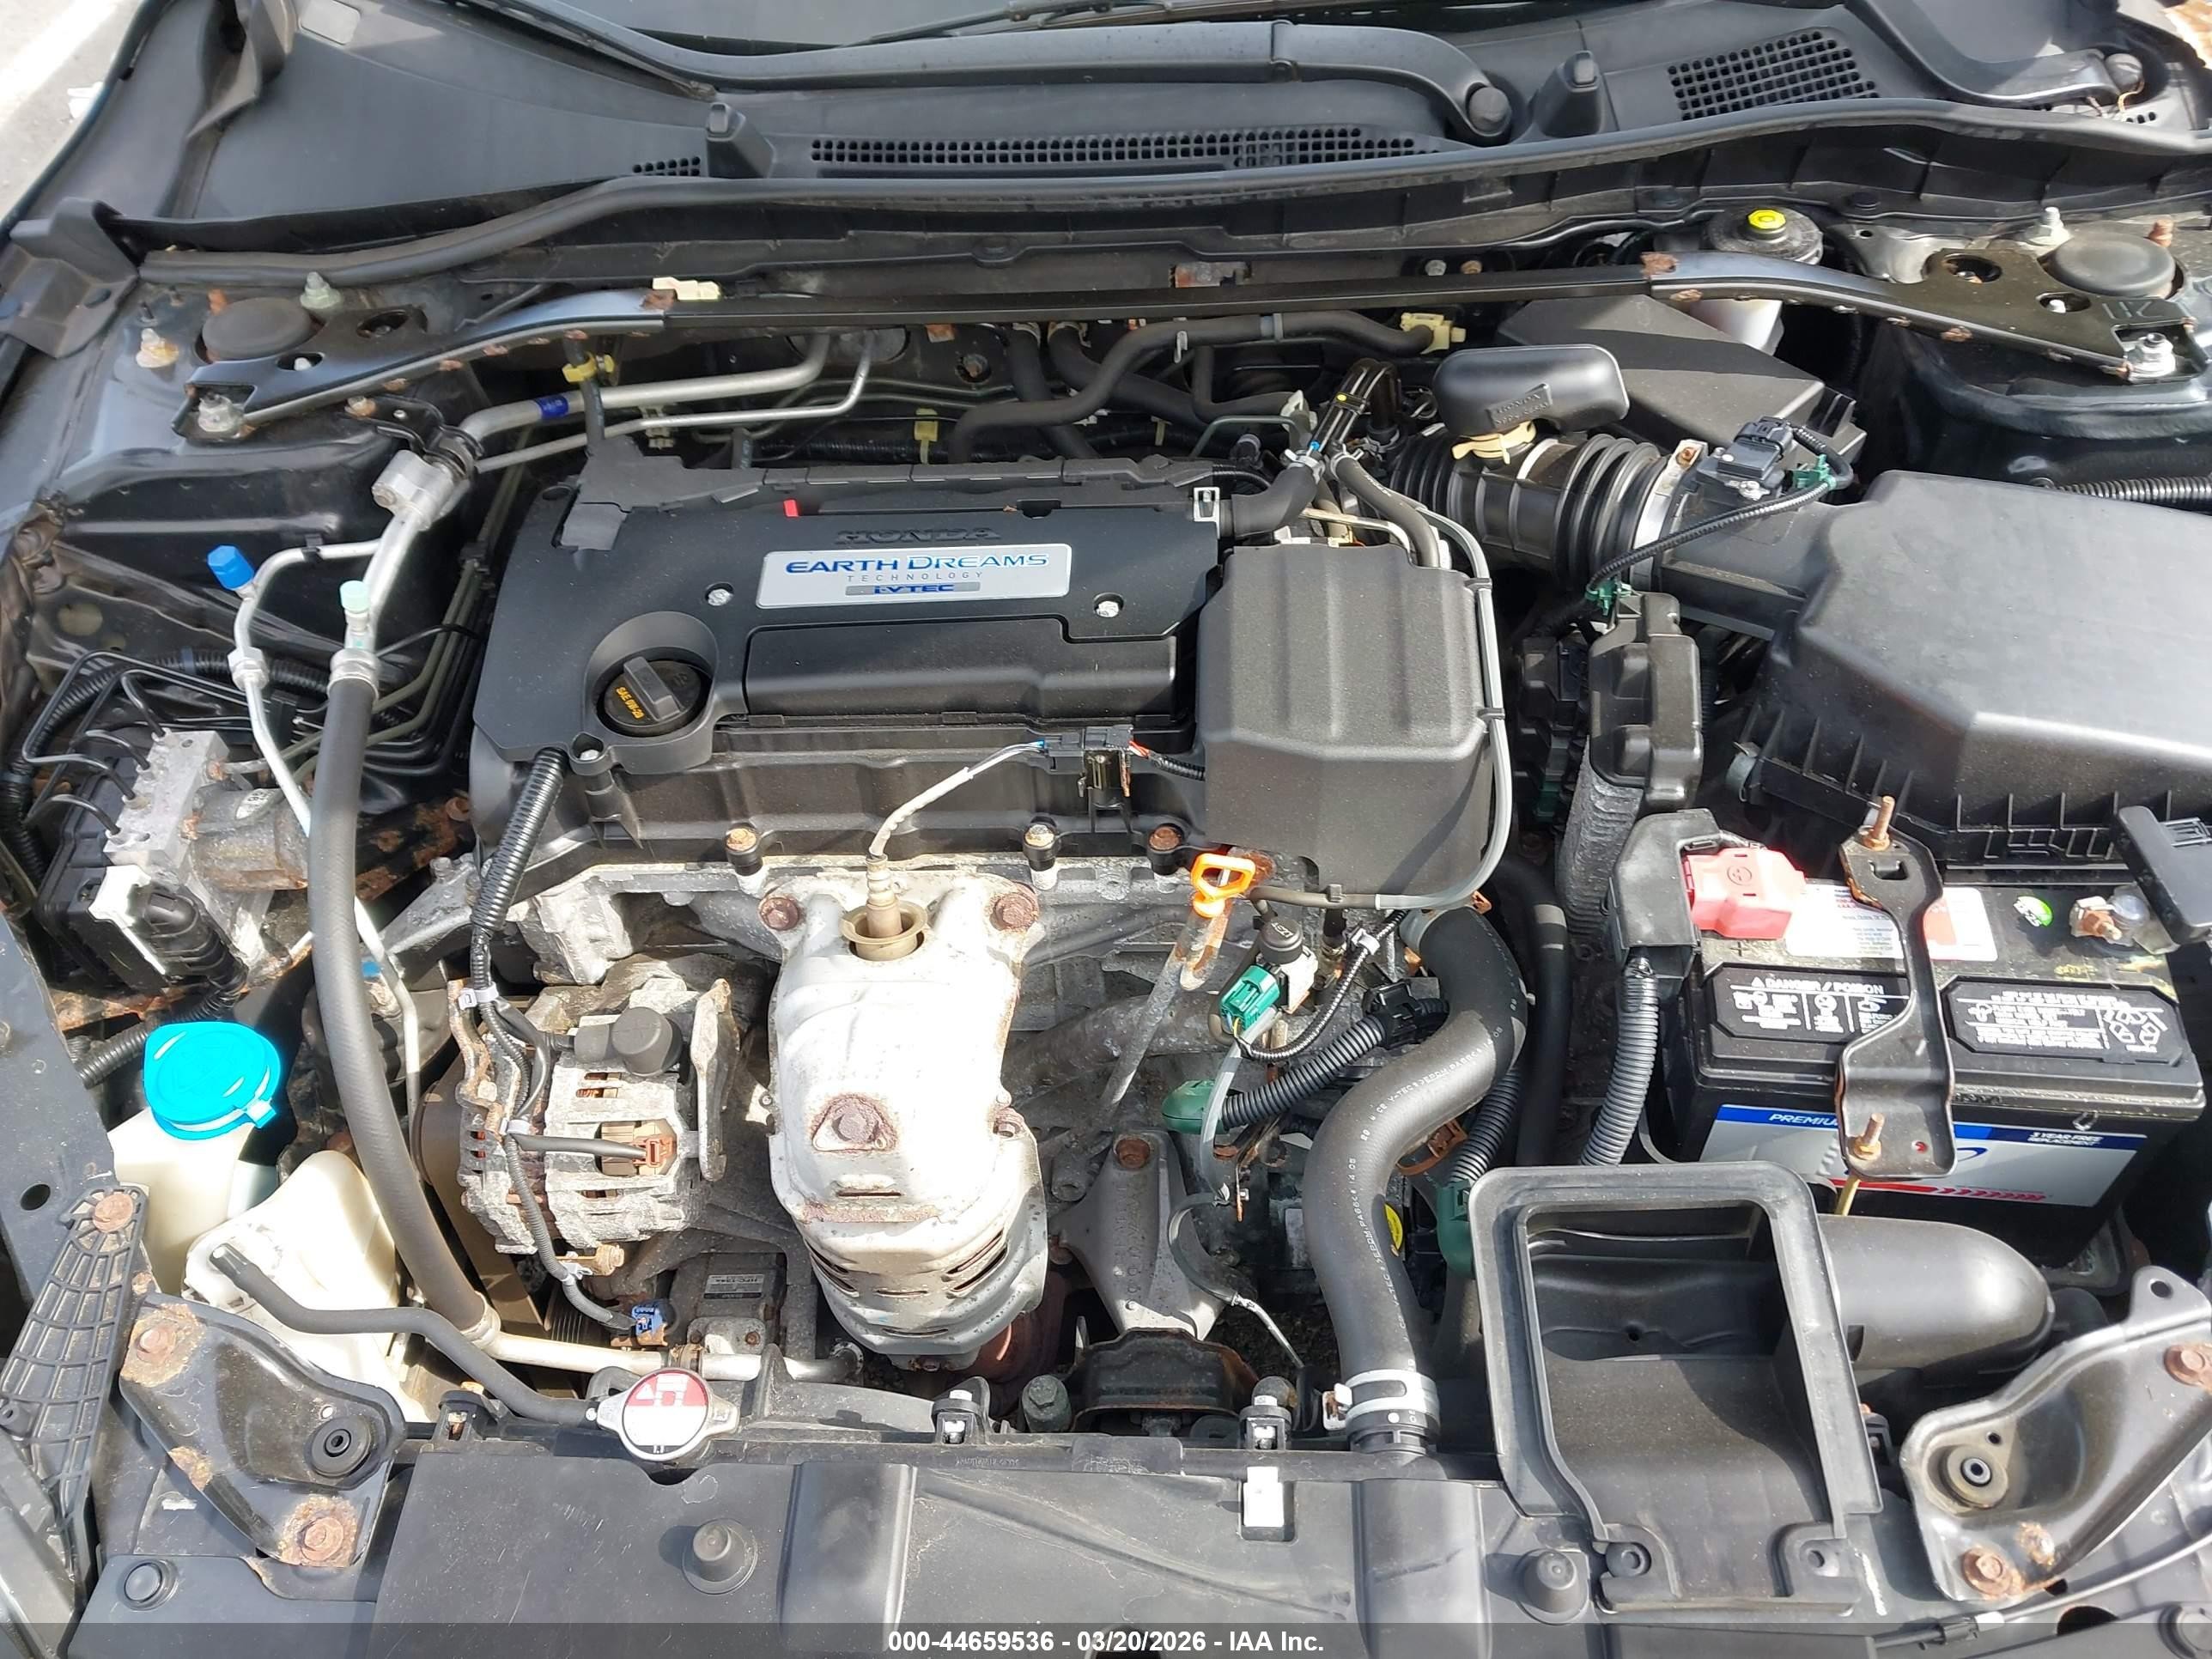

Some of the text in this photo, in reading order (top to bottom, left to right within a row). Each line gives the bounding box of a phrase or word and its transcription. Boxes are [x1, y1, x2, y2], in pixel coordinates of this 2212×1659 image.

[836, 527, 1001, 545] HONDA
[786, 554, 1048, 574] EARTH DREAMS
[847, 571, 983, 582] TECHNOLOGY
[874, 584, 955, 594] i-VTEC
[616, 687, 631, 701] SAE
[1833, 982, 1884, 995] POISON
[1769, 1114, 1838, 1126] PREMIU
